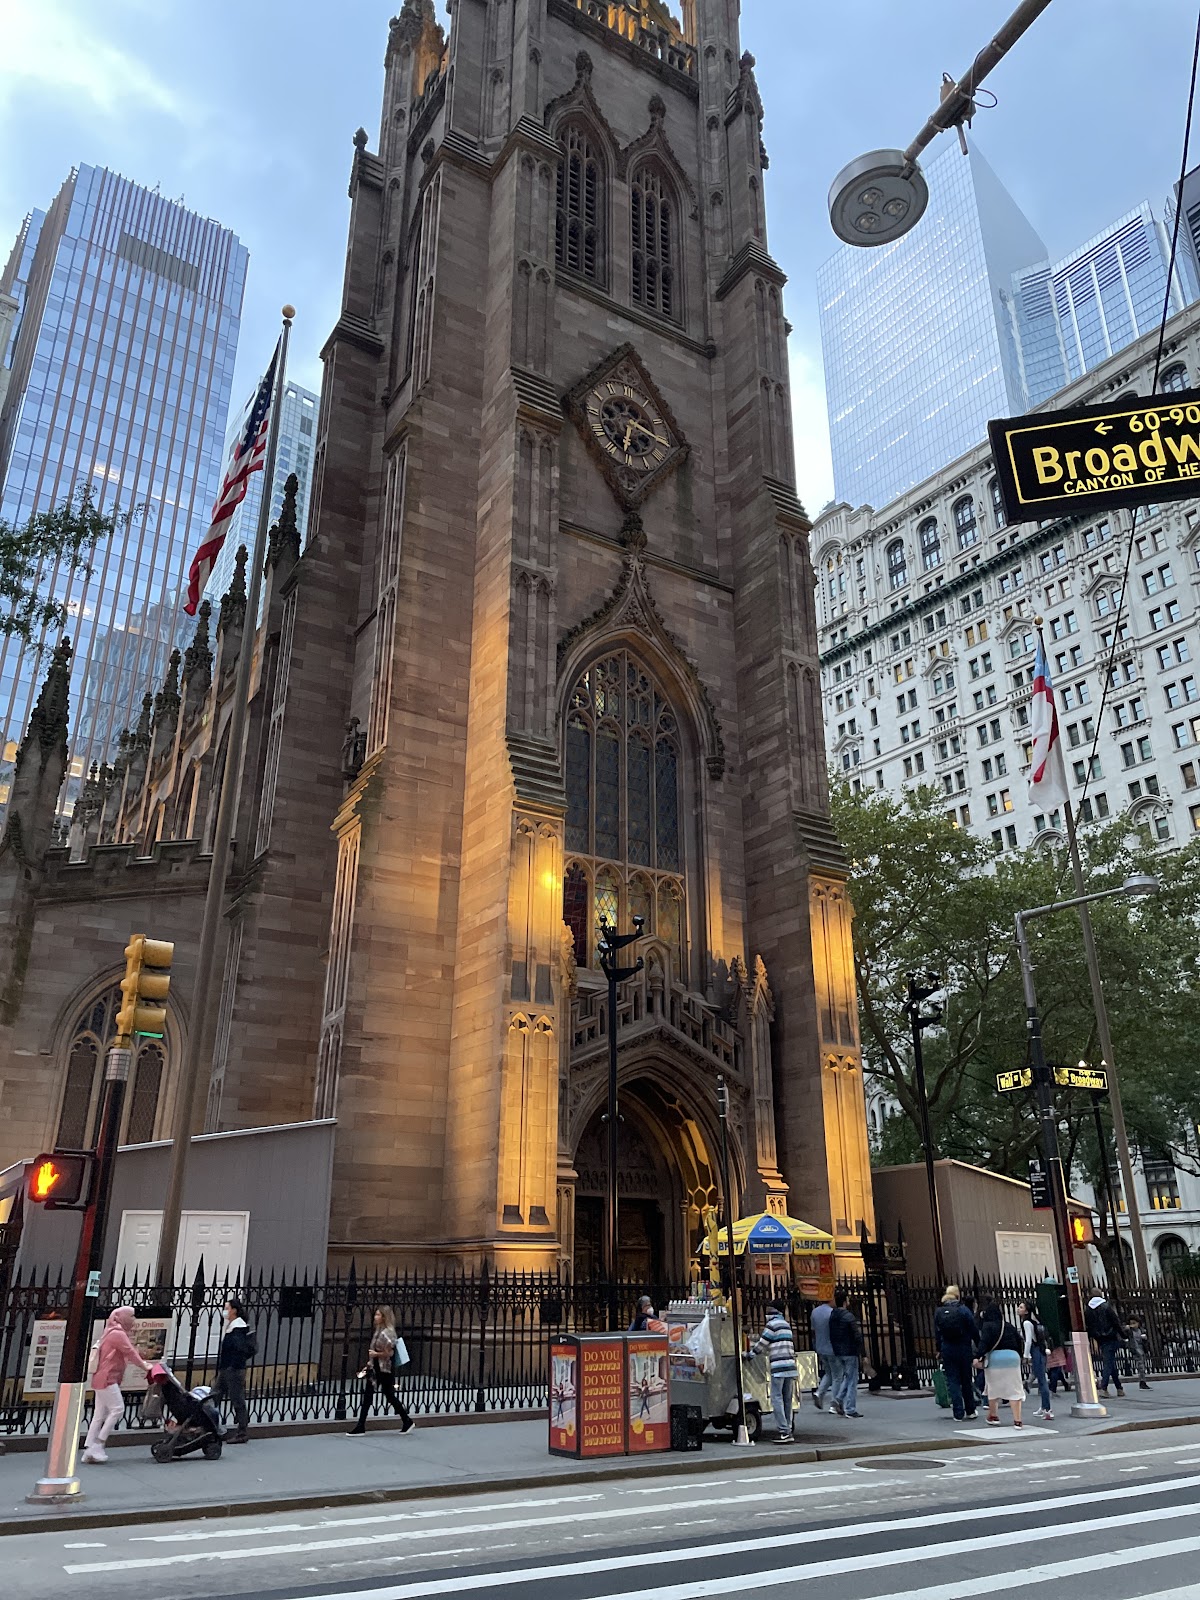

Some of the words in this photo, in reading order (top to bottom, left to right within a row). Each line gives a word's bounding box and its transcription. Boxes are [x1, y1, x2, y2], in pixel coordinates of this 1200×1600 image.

[1129, 405, 1200, 433] 60-90
[1063, 471, 1135, 494] CANYON
[1144, 467, 1166, 482] OF
[1070, 1073, 1104, 1088] Broadway
[795, 1240, 832, 1250] SABRETT
[584, 1351, 598, 1362] DO
[600, 1350, 620, 1361] YOU
[584, 1375, 598, 1387] DO
[600, 1374, 620, 1386] YOU
[584, 1400, 598, 1411] DO
[600, 1398, 620, 1410] YOU
[584, 1425, 598, 1436] DO
[600, 1423, 620, 1435] YOU
